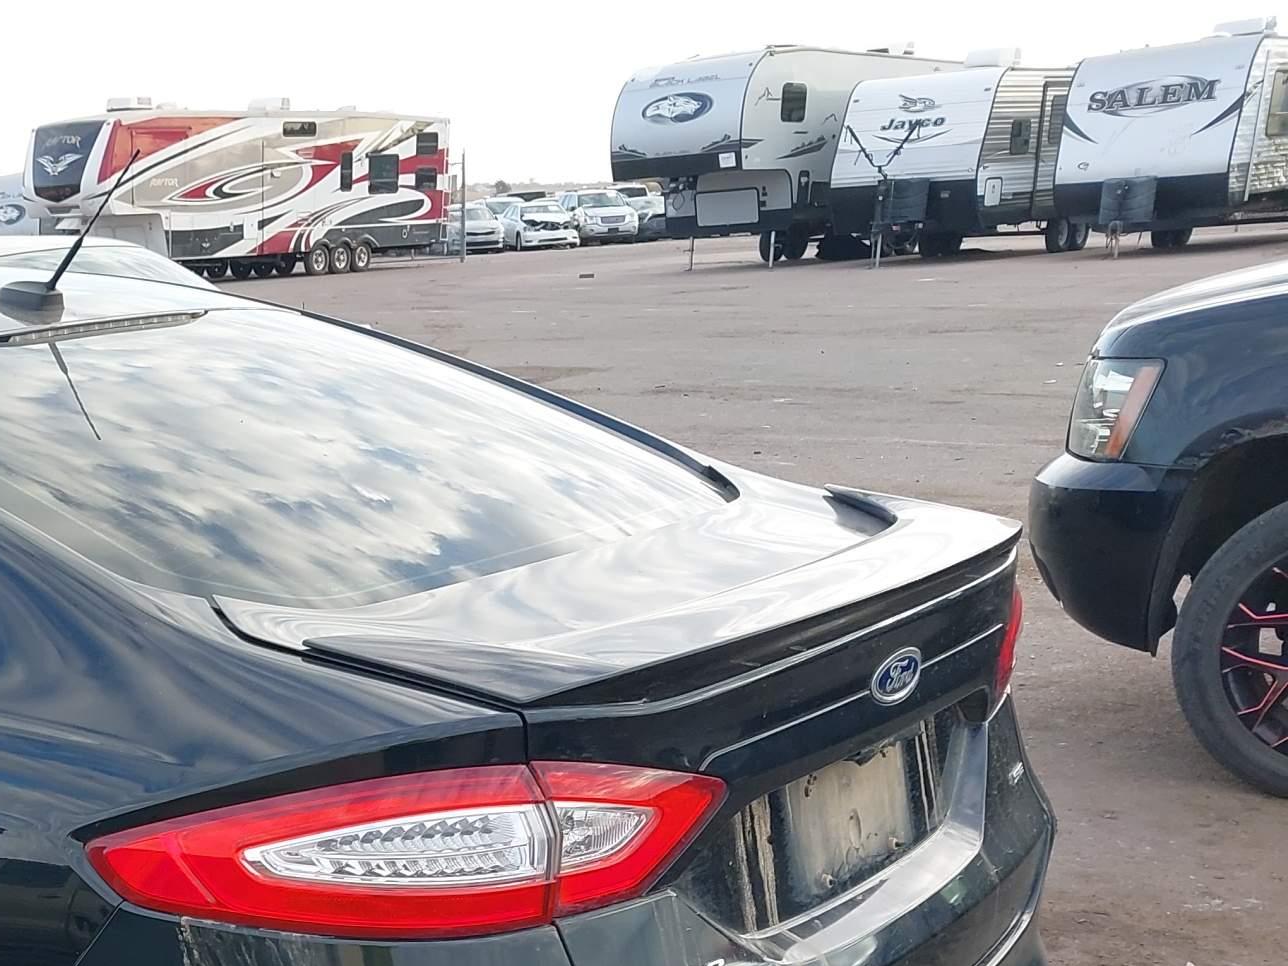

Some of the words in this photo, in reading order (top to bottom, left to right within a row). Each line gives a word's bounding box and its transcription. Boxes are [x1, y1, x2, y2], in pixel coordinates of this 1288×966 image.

[1087, 78, 1221, 112] SALEM
[879, 117, 946, 133] Jayco
[885, 658, 916, 693] Ford
